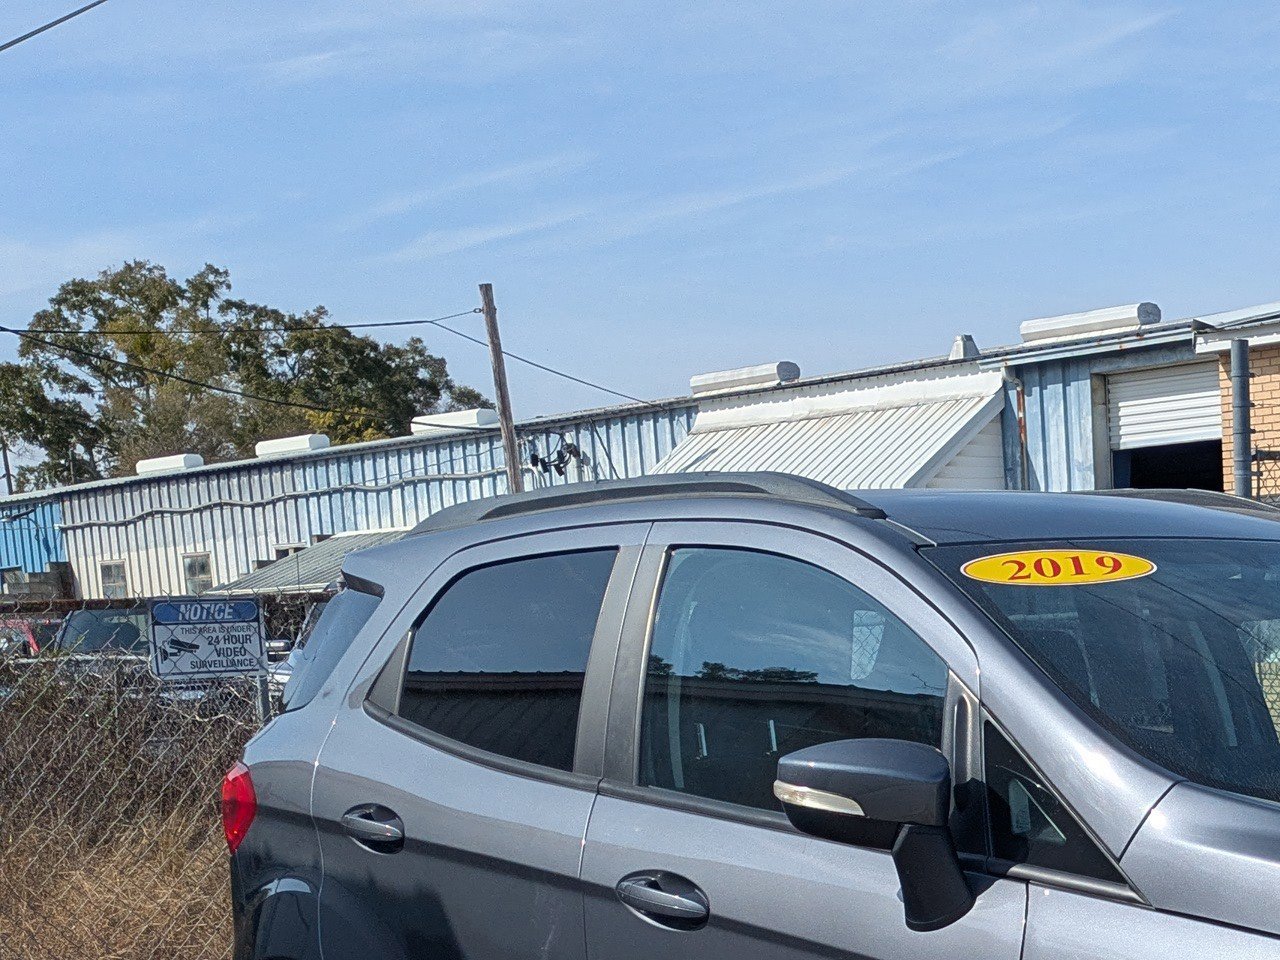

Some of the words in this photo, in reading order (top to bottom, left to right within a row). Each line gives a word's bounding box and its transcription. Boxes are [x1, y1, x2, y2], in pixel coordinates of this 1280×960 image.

[1001, 555, 1123, 581] 2019
[179, 604, 234, 621] NOTICE
[181, 626, 197, 635] THIS
[199, 625, 217, 634] AREA
[219, 625, 227, 634] IS
[227, 625, 252, 633] UNDER
[207, 635, 220, 646] 24
[223, 634, 252, 645] HOUR
[214, 646, 247, 658] VIDEO
[190, 659, 254, 669] SURVEILLANCE
